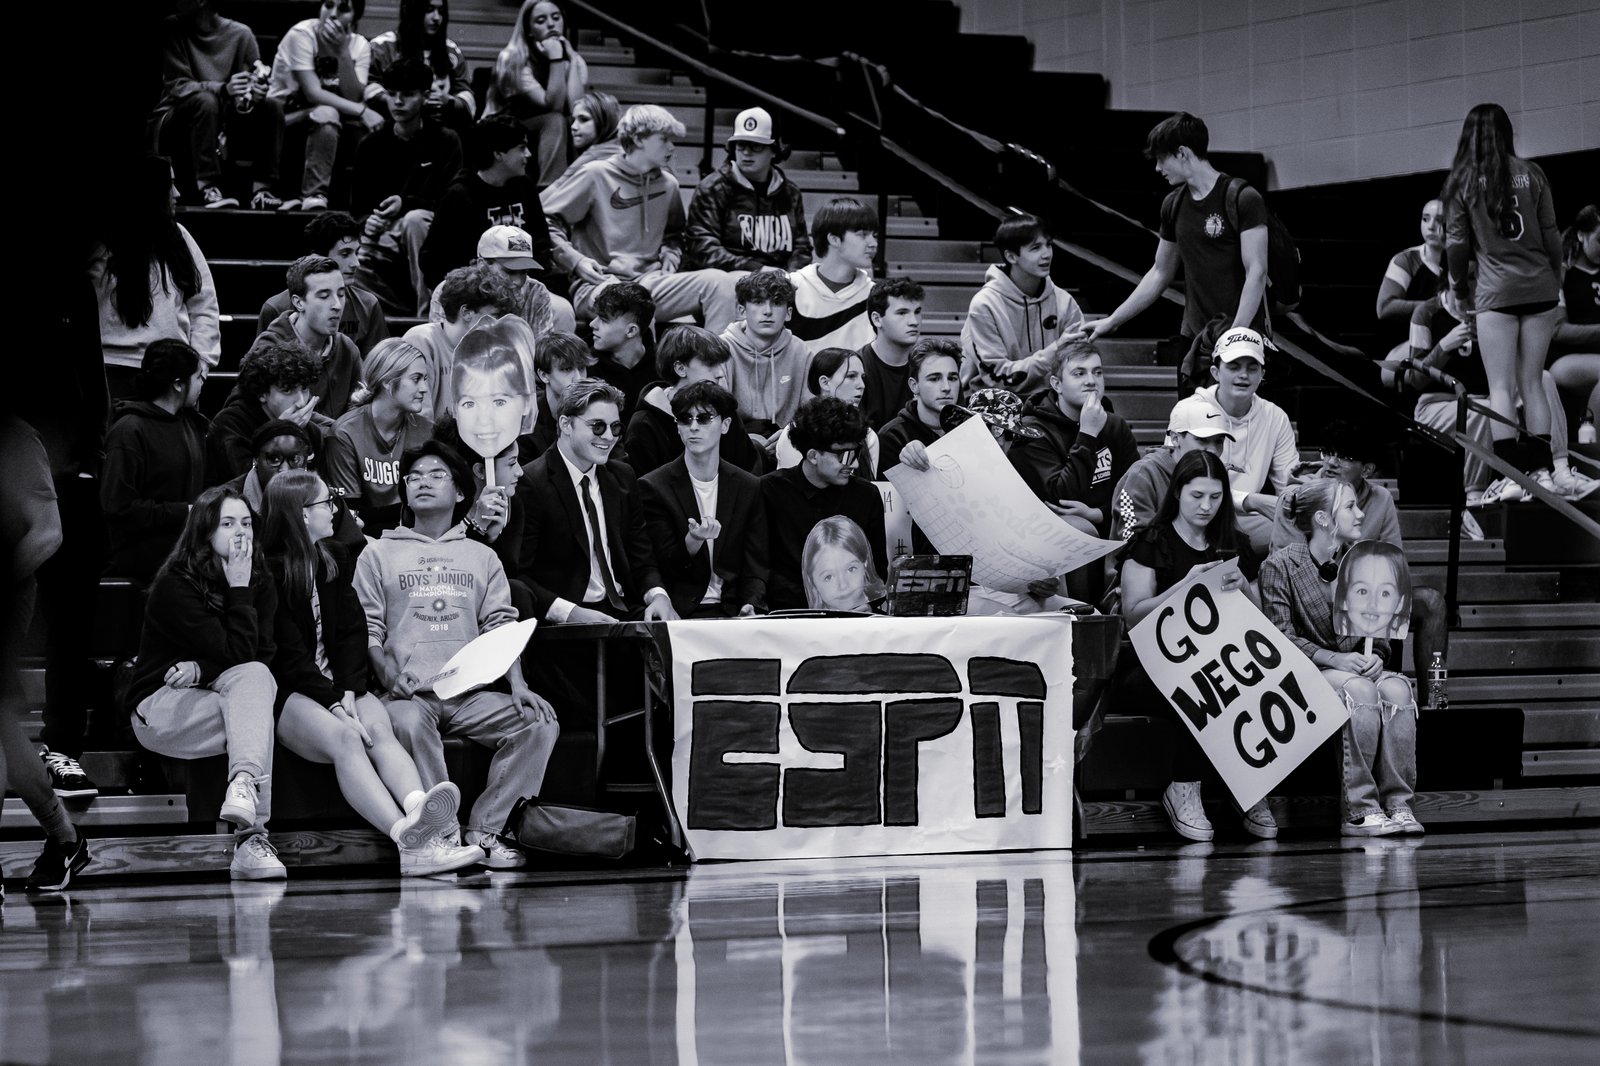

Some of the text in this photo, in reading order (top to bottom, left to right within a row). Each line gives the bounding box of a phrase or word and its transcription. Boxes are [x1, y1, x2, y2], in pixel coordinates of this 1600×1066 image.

[1225, 333, 1261, 347] Titleist
[398, 573, 475, 590] BOYS' JUNIOR
[896, 569, 967, 593] ESPN
[408, 590, 467, 598] CHAMPIONSHIPS
[412, 611, 440, 622] PHOENIX,
[1155, 583, 1220, 663] GO
[1170, 629, 1282, 733] WEGO
[1233, 670, 1317, 769] GO!
[687, 652, 1048, 831] ESPN
